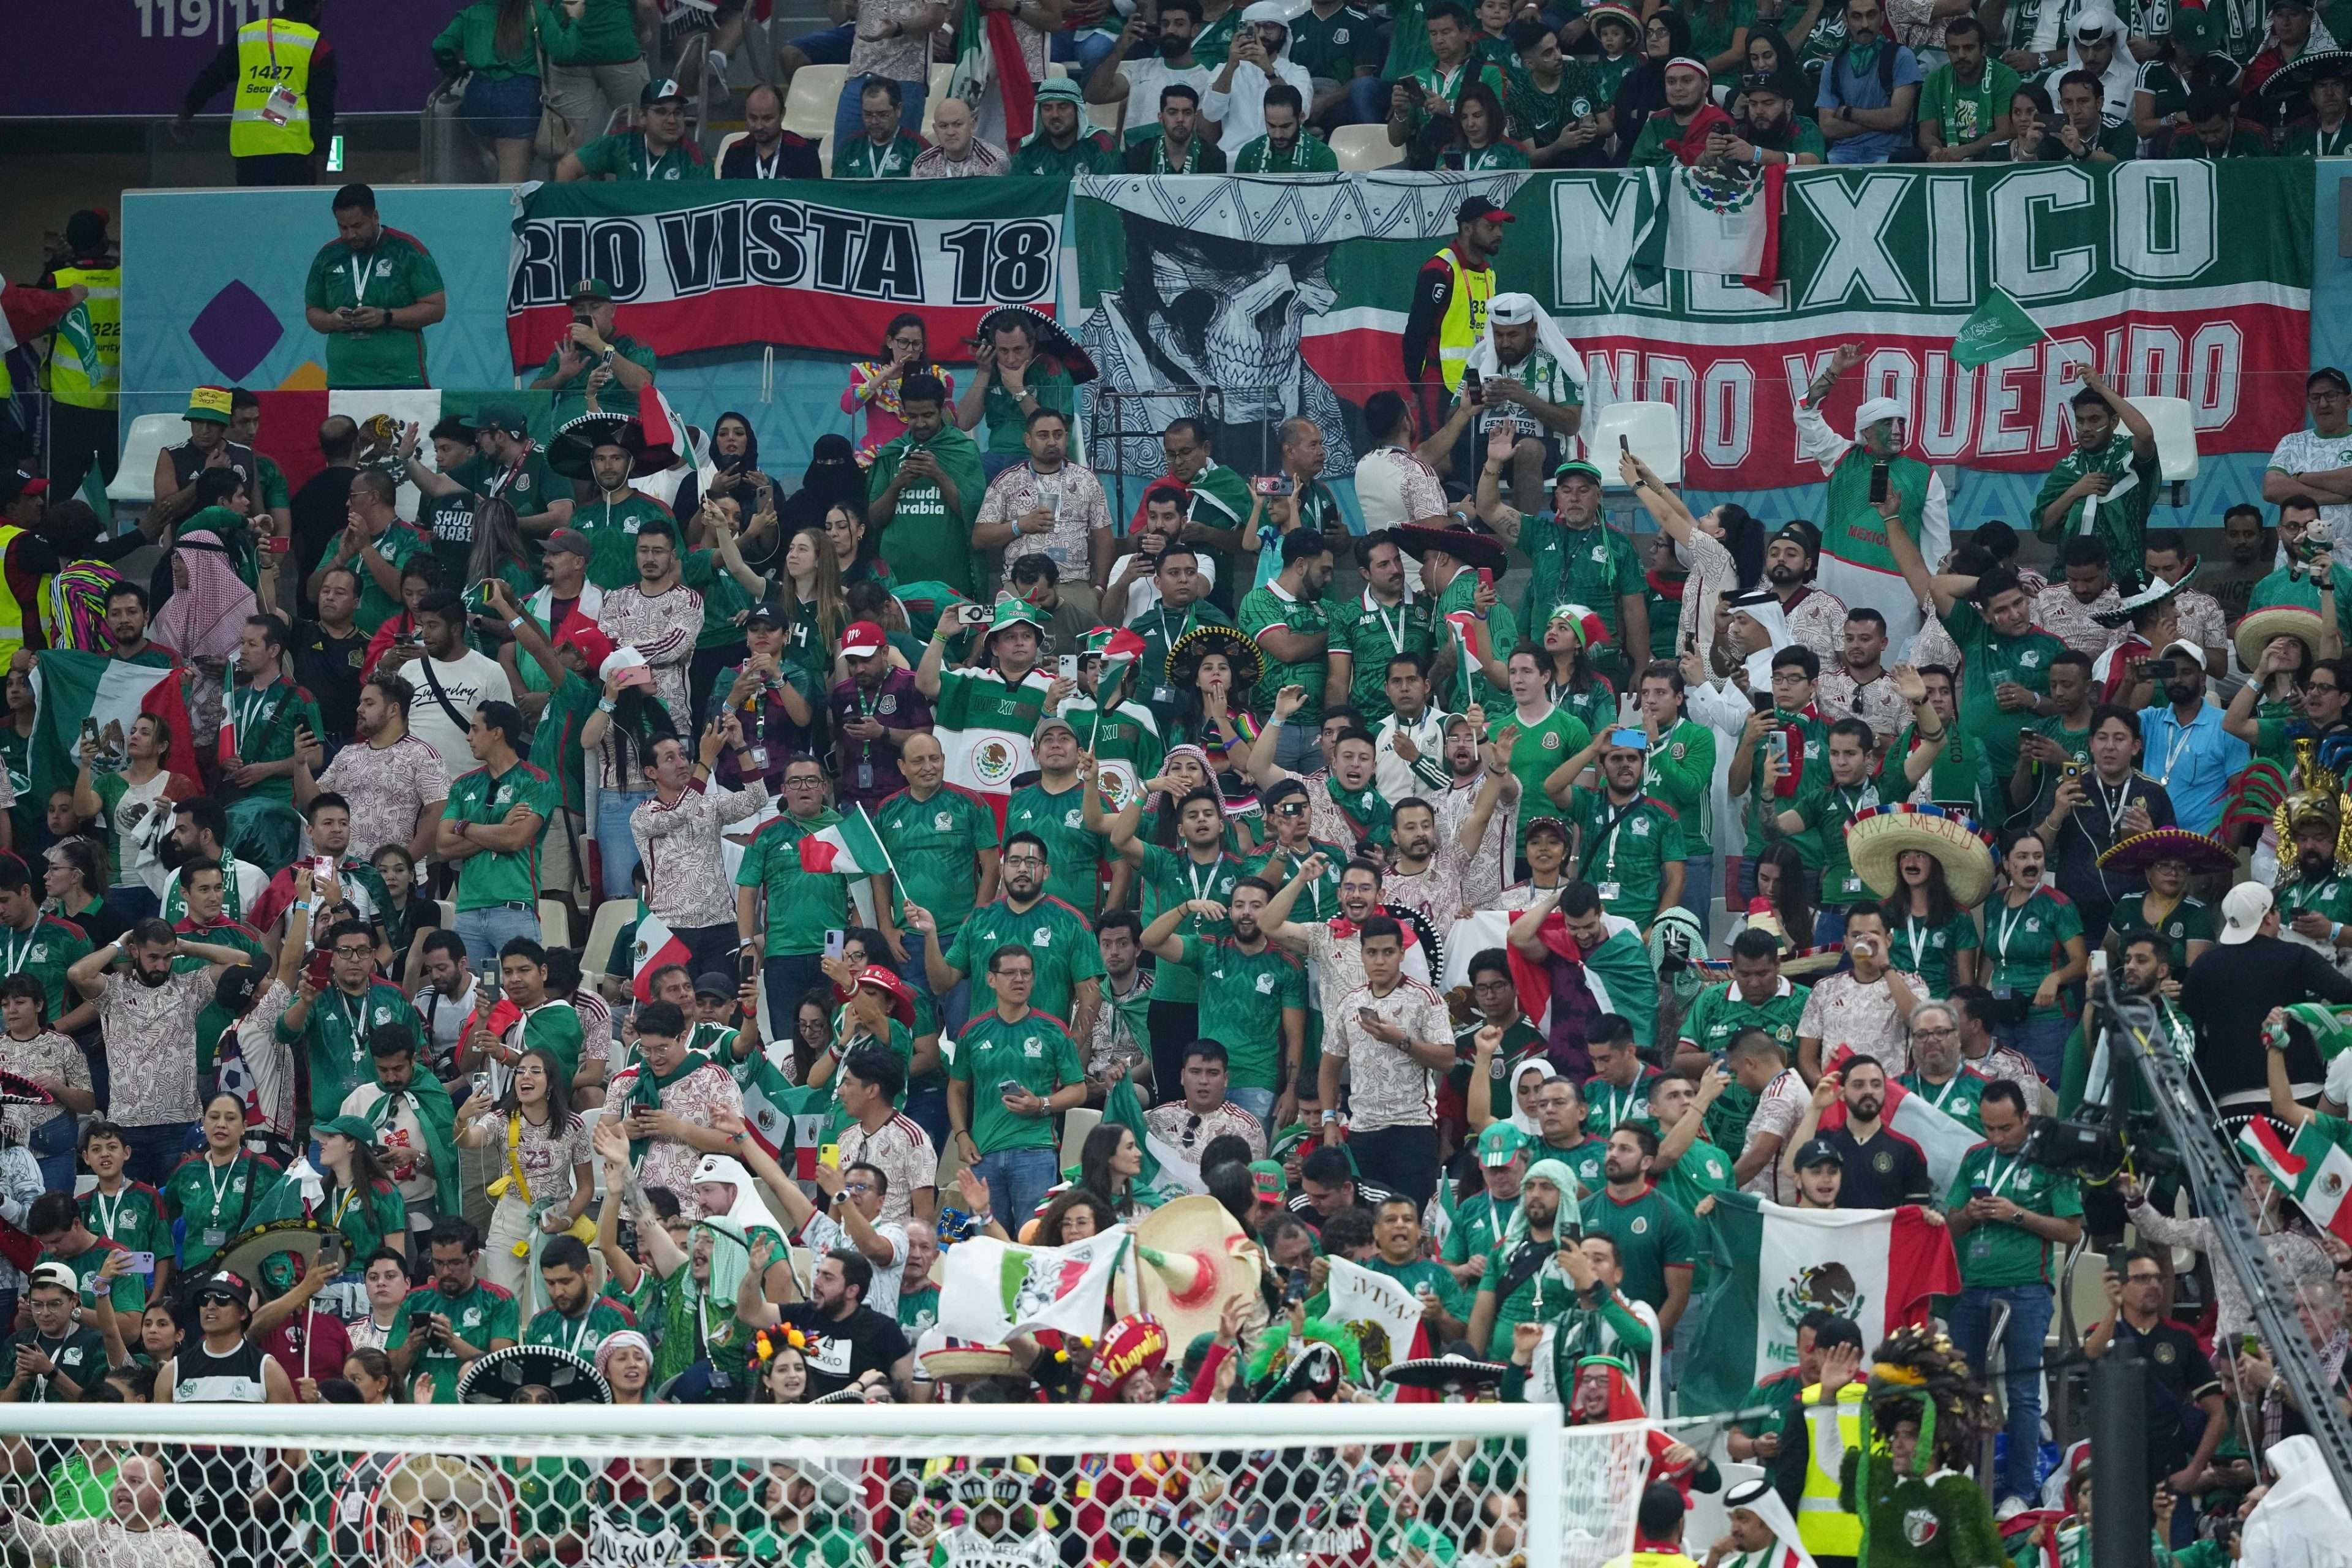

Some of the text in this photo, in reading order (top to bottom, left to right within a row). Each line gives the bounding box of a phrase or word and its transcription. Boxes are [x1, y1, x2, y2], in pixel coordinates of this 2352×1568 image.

[135, 0, 211, 37] 119
[249, 65, 294, 80] 1427
[655, 199, 925, 304] VISTA
[940, 218, 1056, 306] 18
[1578, 349, 1755, 469] NDO
[1783, 348, 1838, 464] Y
[1485, 420, 1536, 429] CEMNTOS
[898, 486, 941, 500] Saudi
[895, 500, 944, 514] Arabia
[435, 510, 474, 526] SAUD
[432, 525, 474, 542] ARABI
[411, 682, 478, 707] Suprdry
[1853, 812, 1975, 850] VIVA MEXICO
